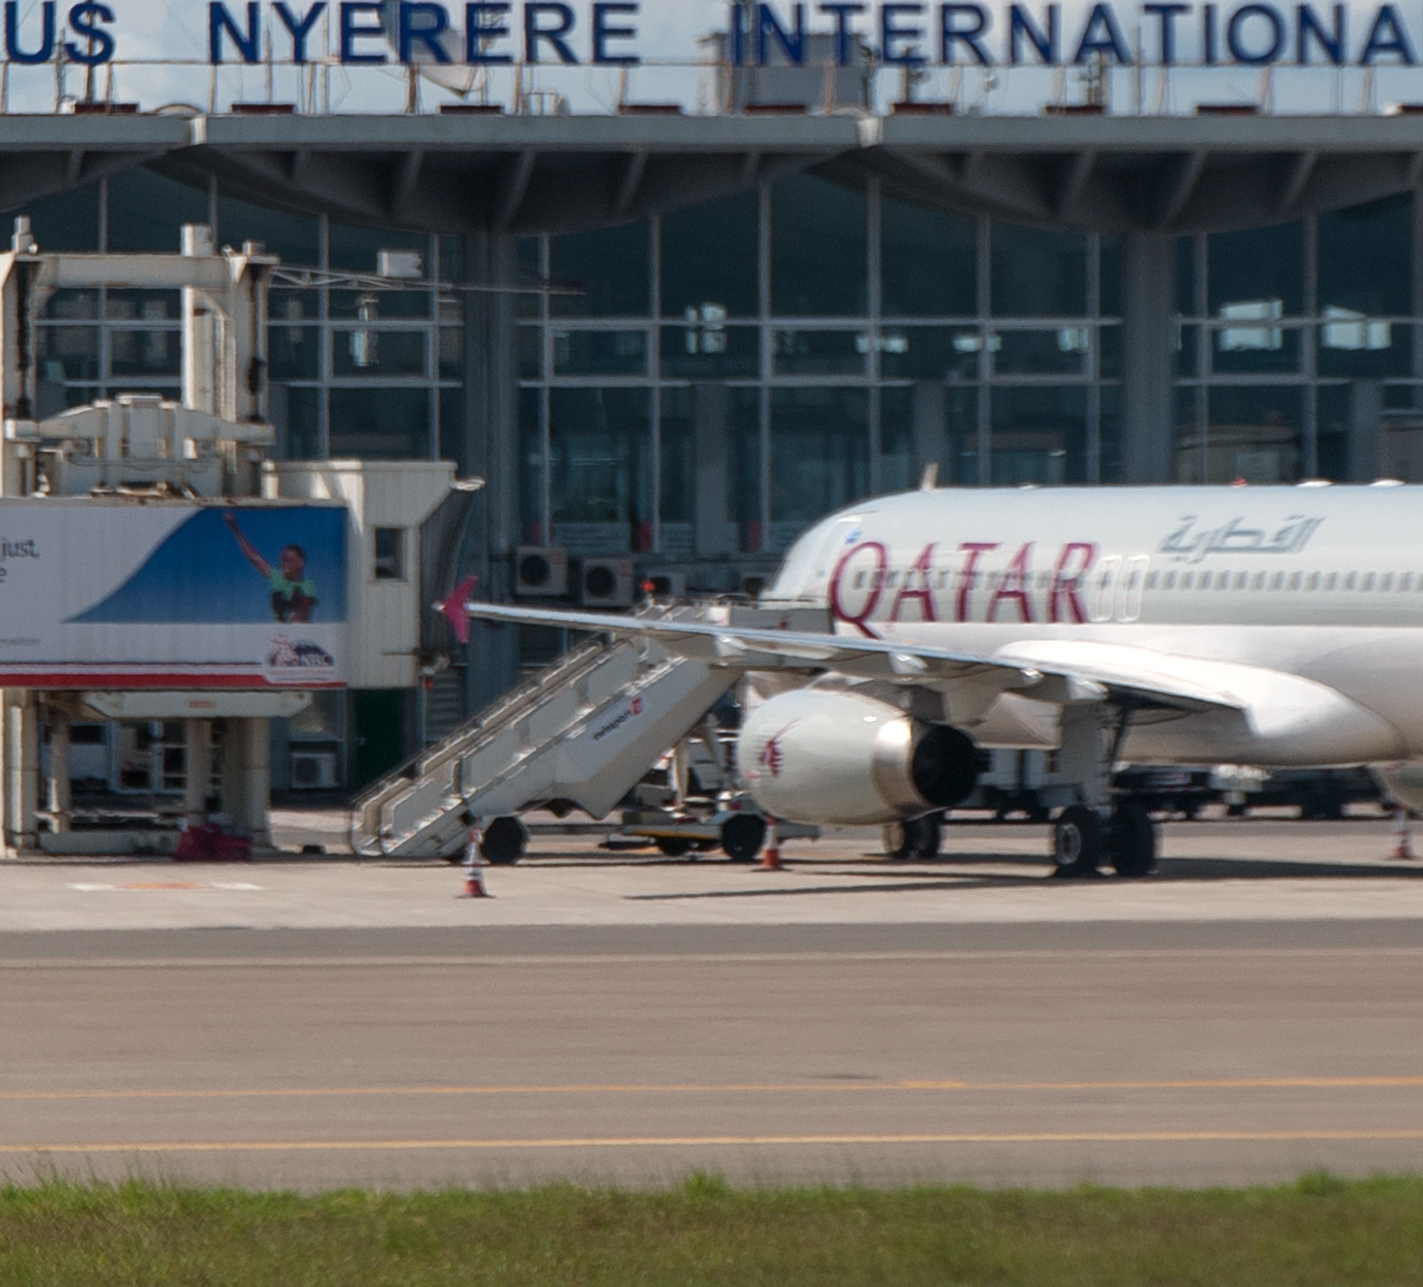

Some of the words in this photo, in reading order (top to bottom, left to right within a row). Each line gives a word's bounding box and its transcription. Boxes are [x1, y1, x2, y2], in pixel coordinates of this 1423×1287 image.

[208, 0, 641, 66] NYERERE
[1159, 514, 1326, 564] القطرية
[829, 541, 1099, 640] QATAR
